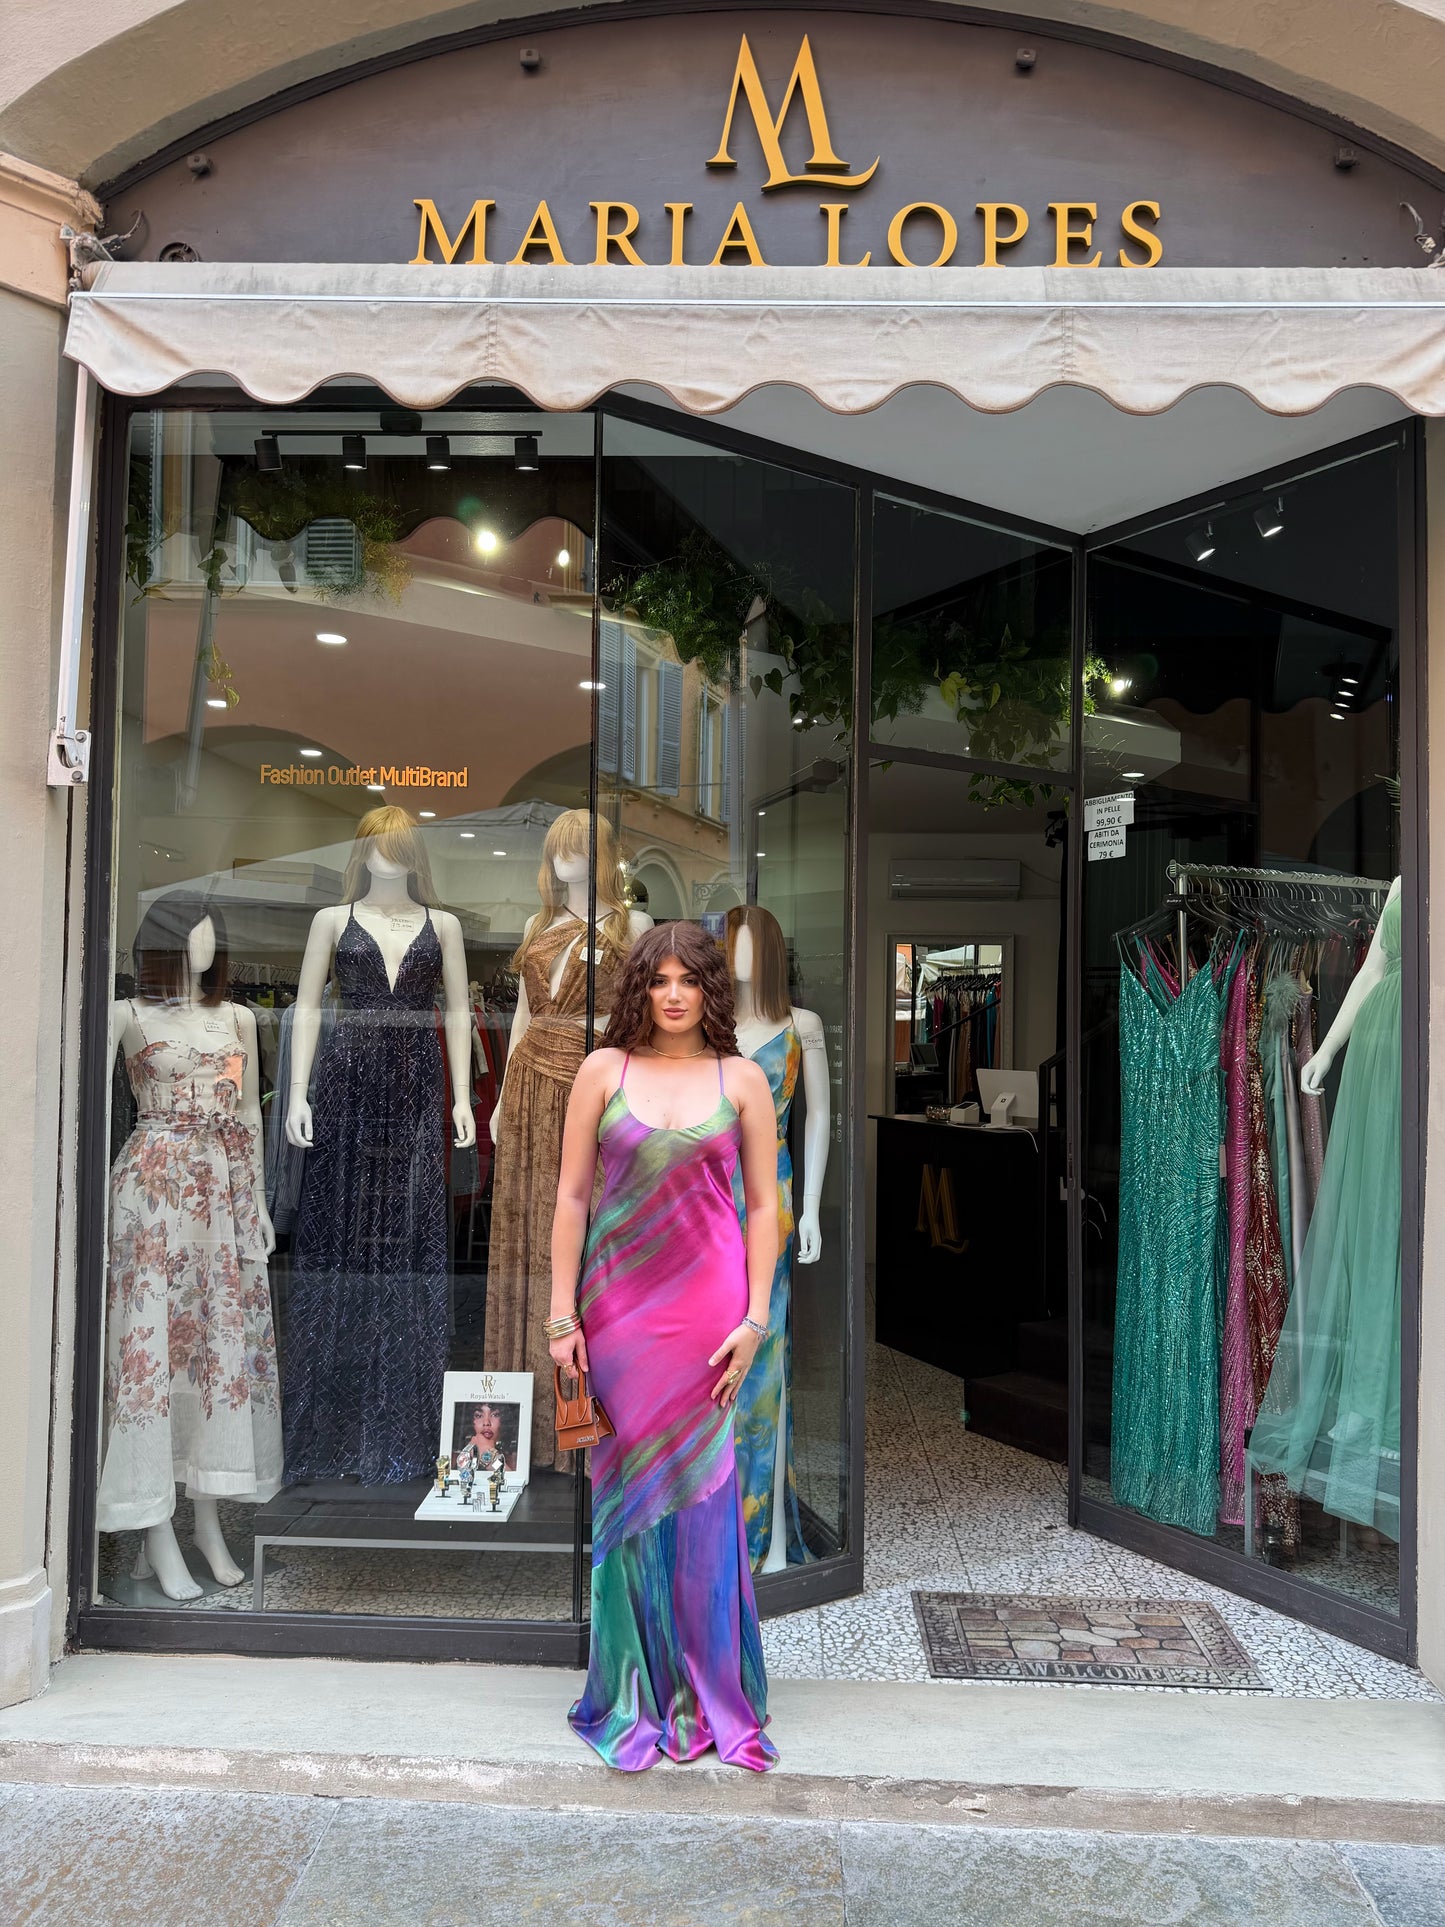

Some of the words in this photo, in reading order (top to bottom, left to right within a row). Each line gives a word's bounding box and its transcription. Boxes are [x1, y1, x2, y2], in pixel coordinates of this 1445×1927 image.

[408, 199, 772, 267] MARIA
[819, 200, 1165, 269] LOPES
[260, 764, 325, 785] Fashion
[327, 765, 377, 786] Outlet
[379, 766, 469, 788] MultiBrand
[1084, 792, 1134, 807] ABBIGLIAMENTO
[1104, 805, 1121, 814] PELLE
[1096, 817, 1116, 827] 99,90
[1094, 830, 1109, 838] ABITI
[1089, 839, 1124, 848] CERIMONIA
[1098, 851, 1107, 859] 79
[1026, 1662, 1165, 1681] WELCOME
